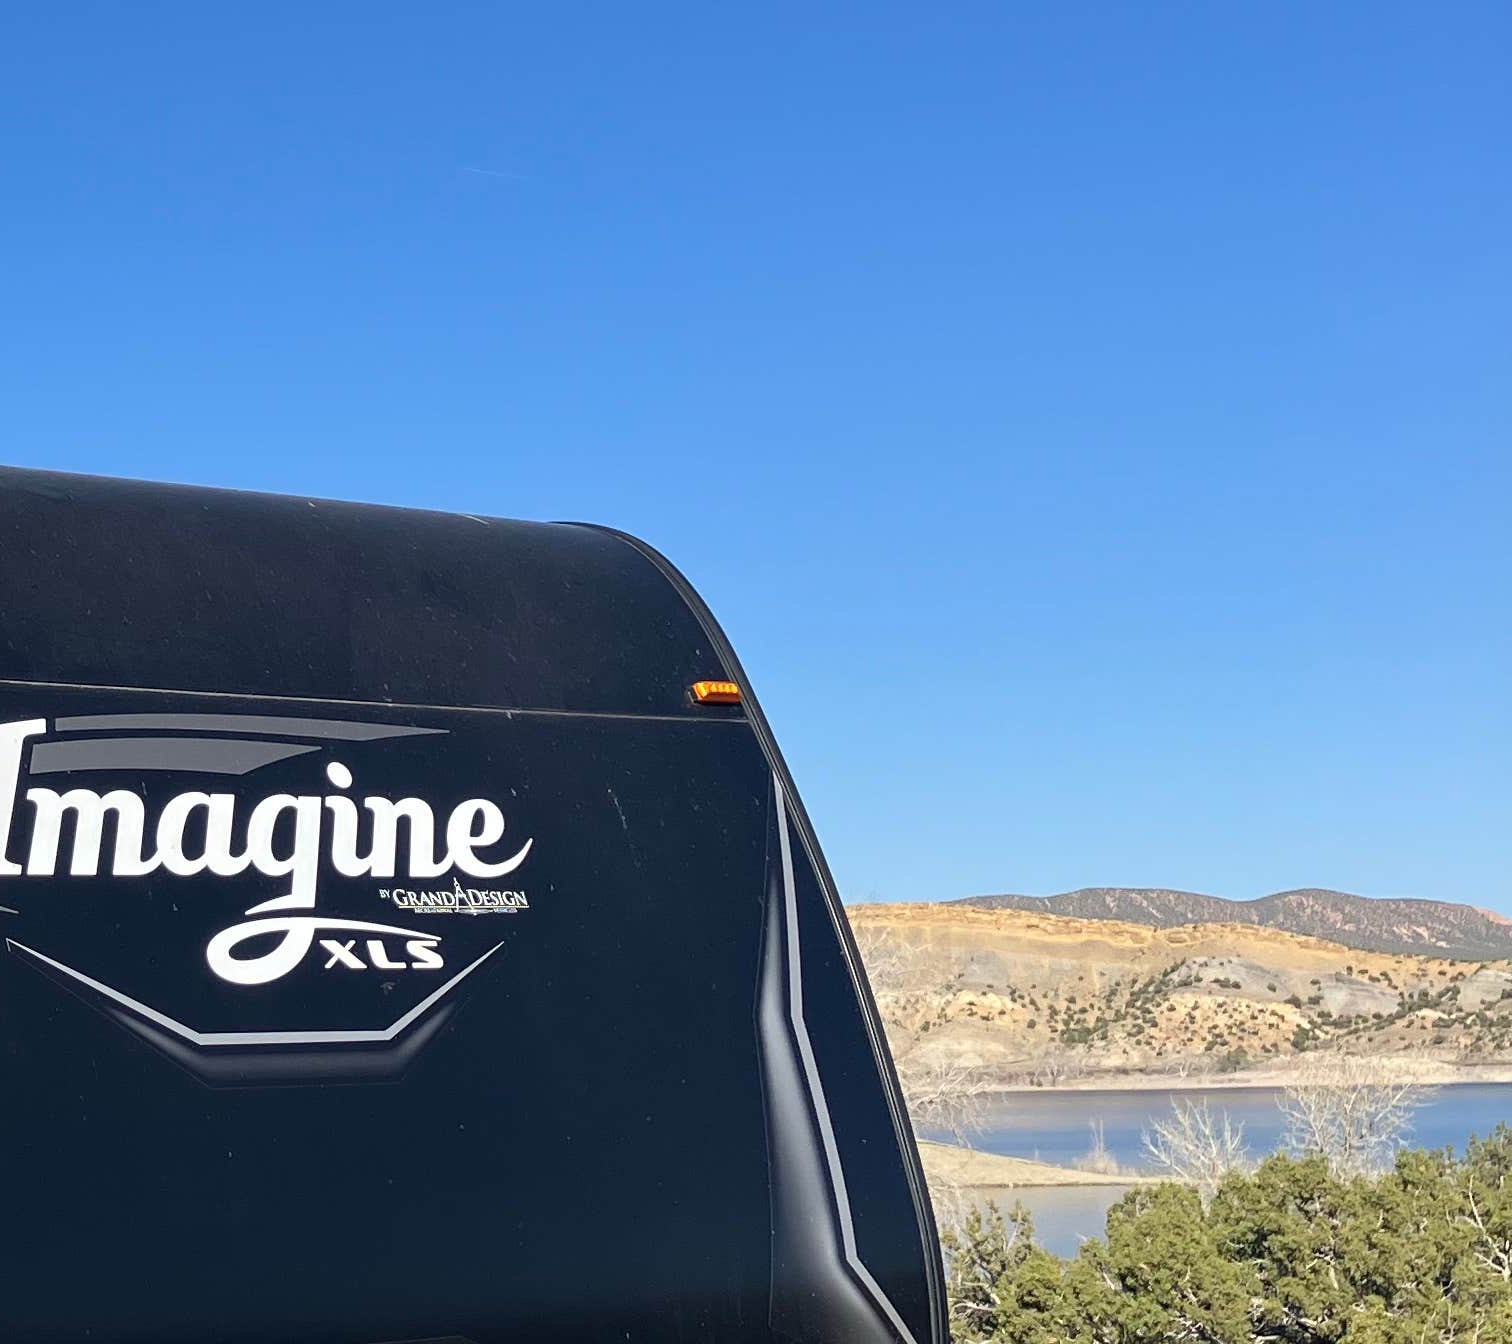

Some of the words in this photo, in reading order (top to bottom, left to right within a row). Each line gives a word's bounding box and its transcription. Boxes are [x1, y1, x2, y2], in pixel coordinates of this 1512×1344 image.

[392, 888, 456, 907] GRAND
[465, 888, 529, 907] DESIGN
[321, 939, 444, 969] XLS
